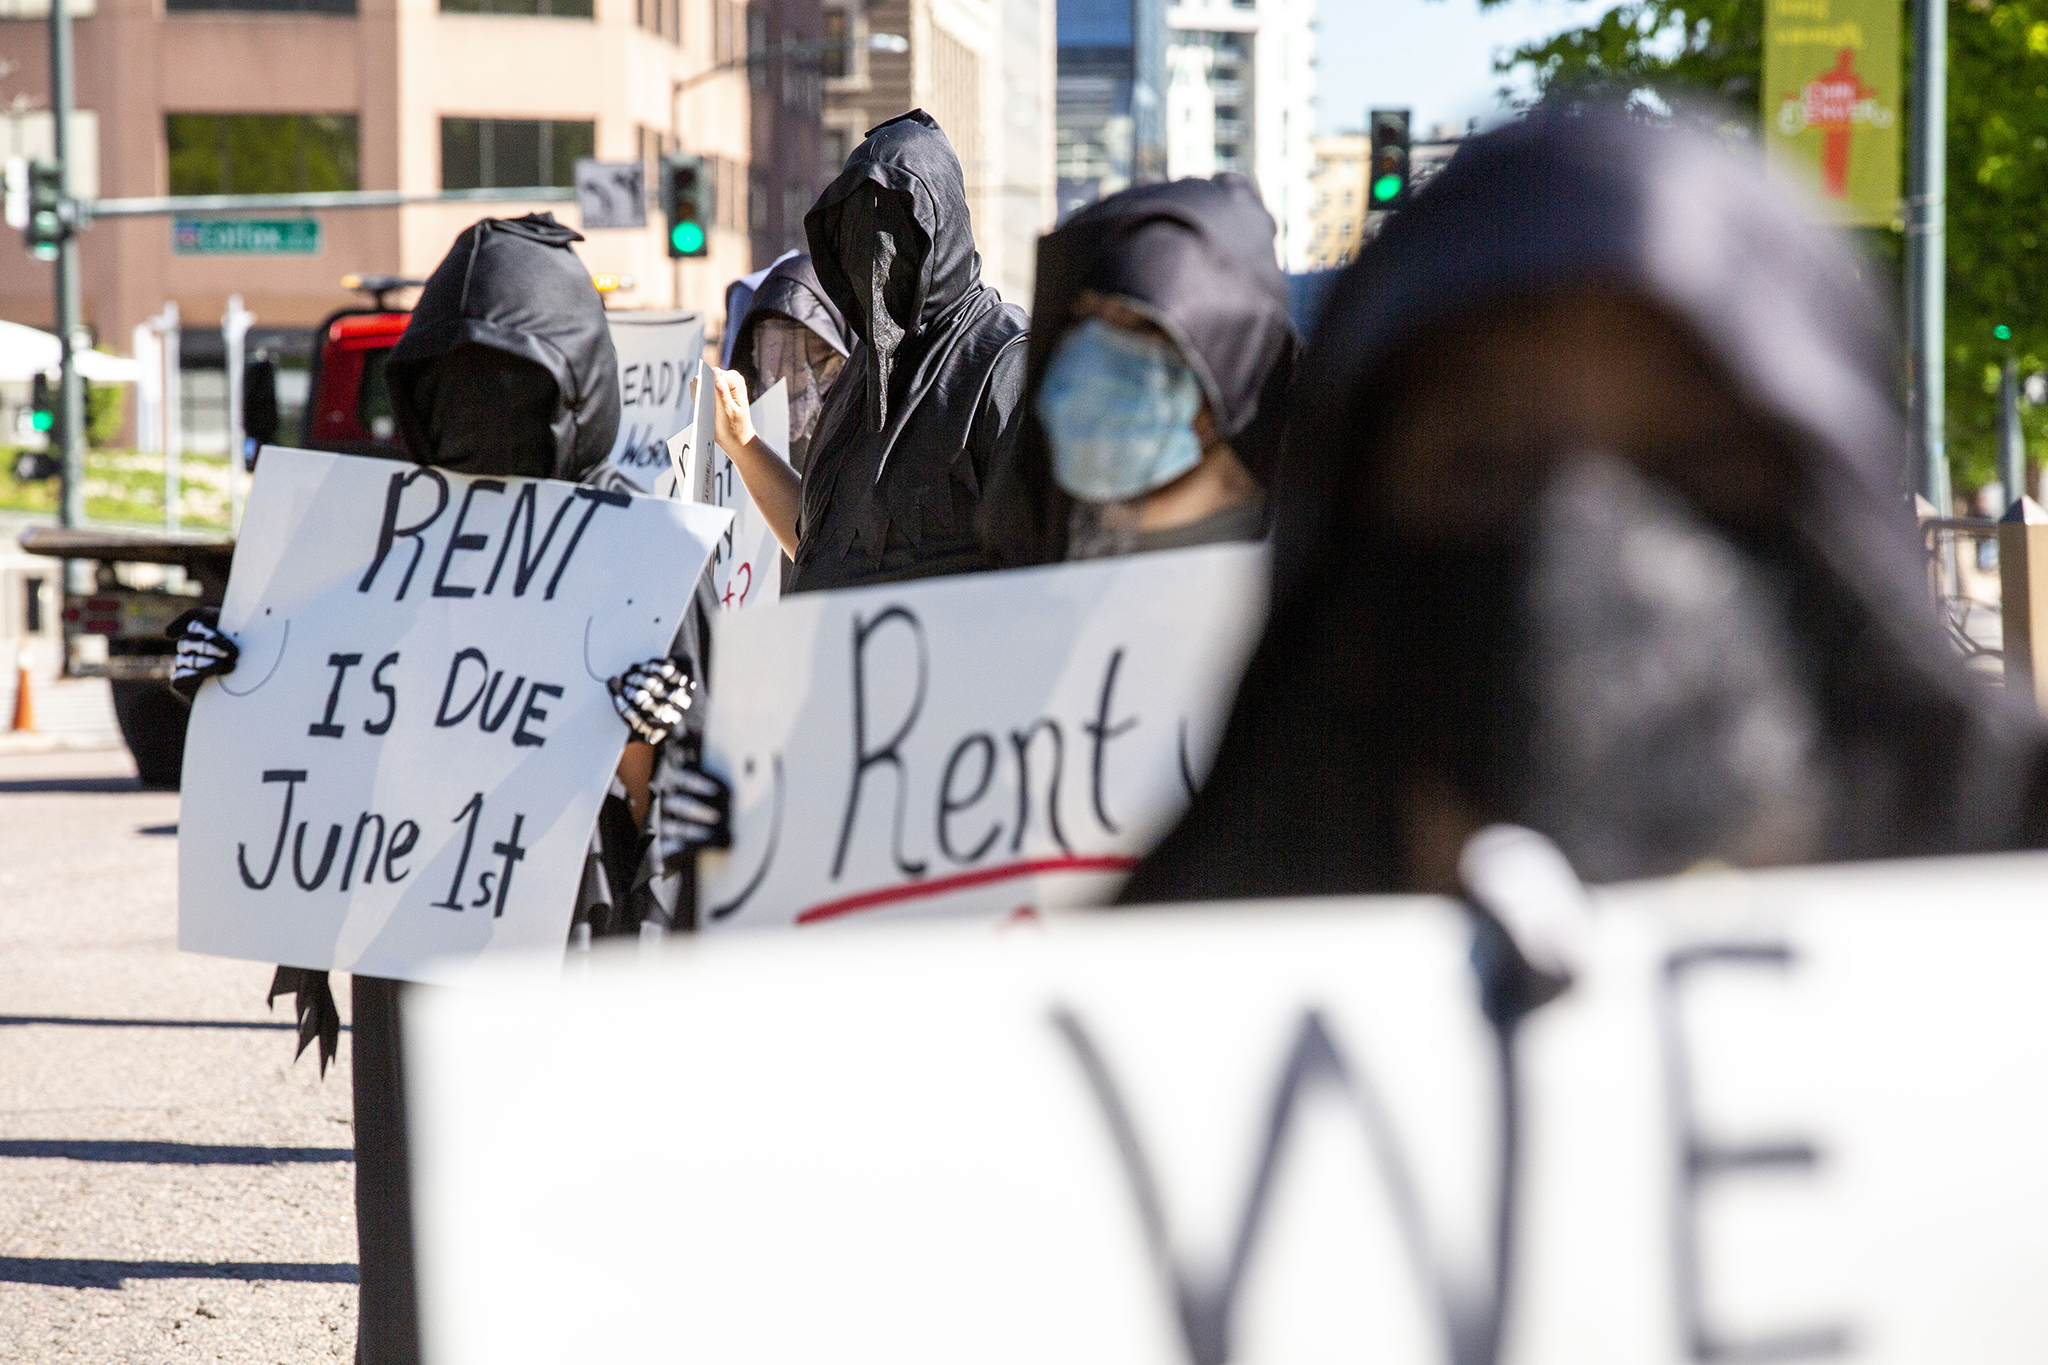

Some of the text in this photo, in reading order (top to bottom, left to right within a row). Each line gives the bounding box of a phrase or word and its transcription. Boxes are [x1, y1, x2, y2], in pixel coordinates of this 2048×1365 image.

[357, 465, 633, 601] RENT
[308, 650, 400, 739] IS
[831, 604, 1138, 881] Rent
[237, 769, 526, 918] June 1st
[1045, 943, 1858, 1365] WE
